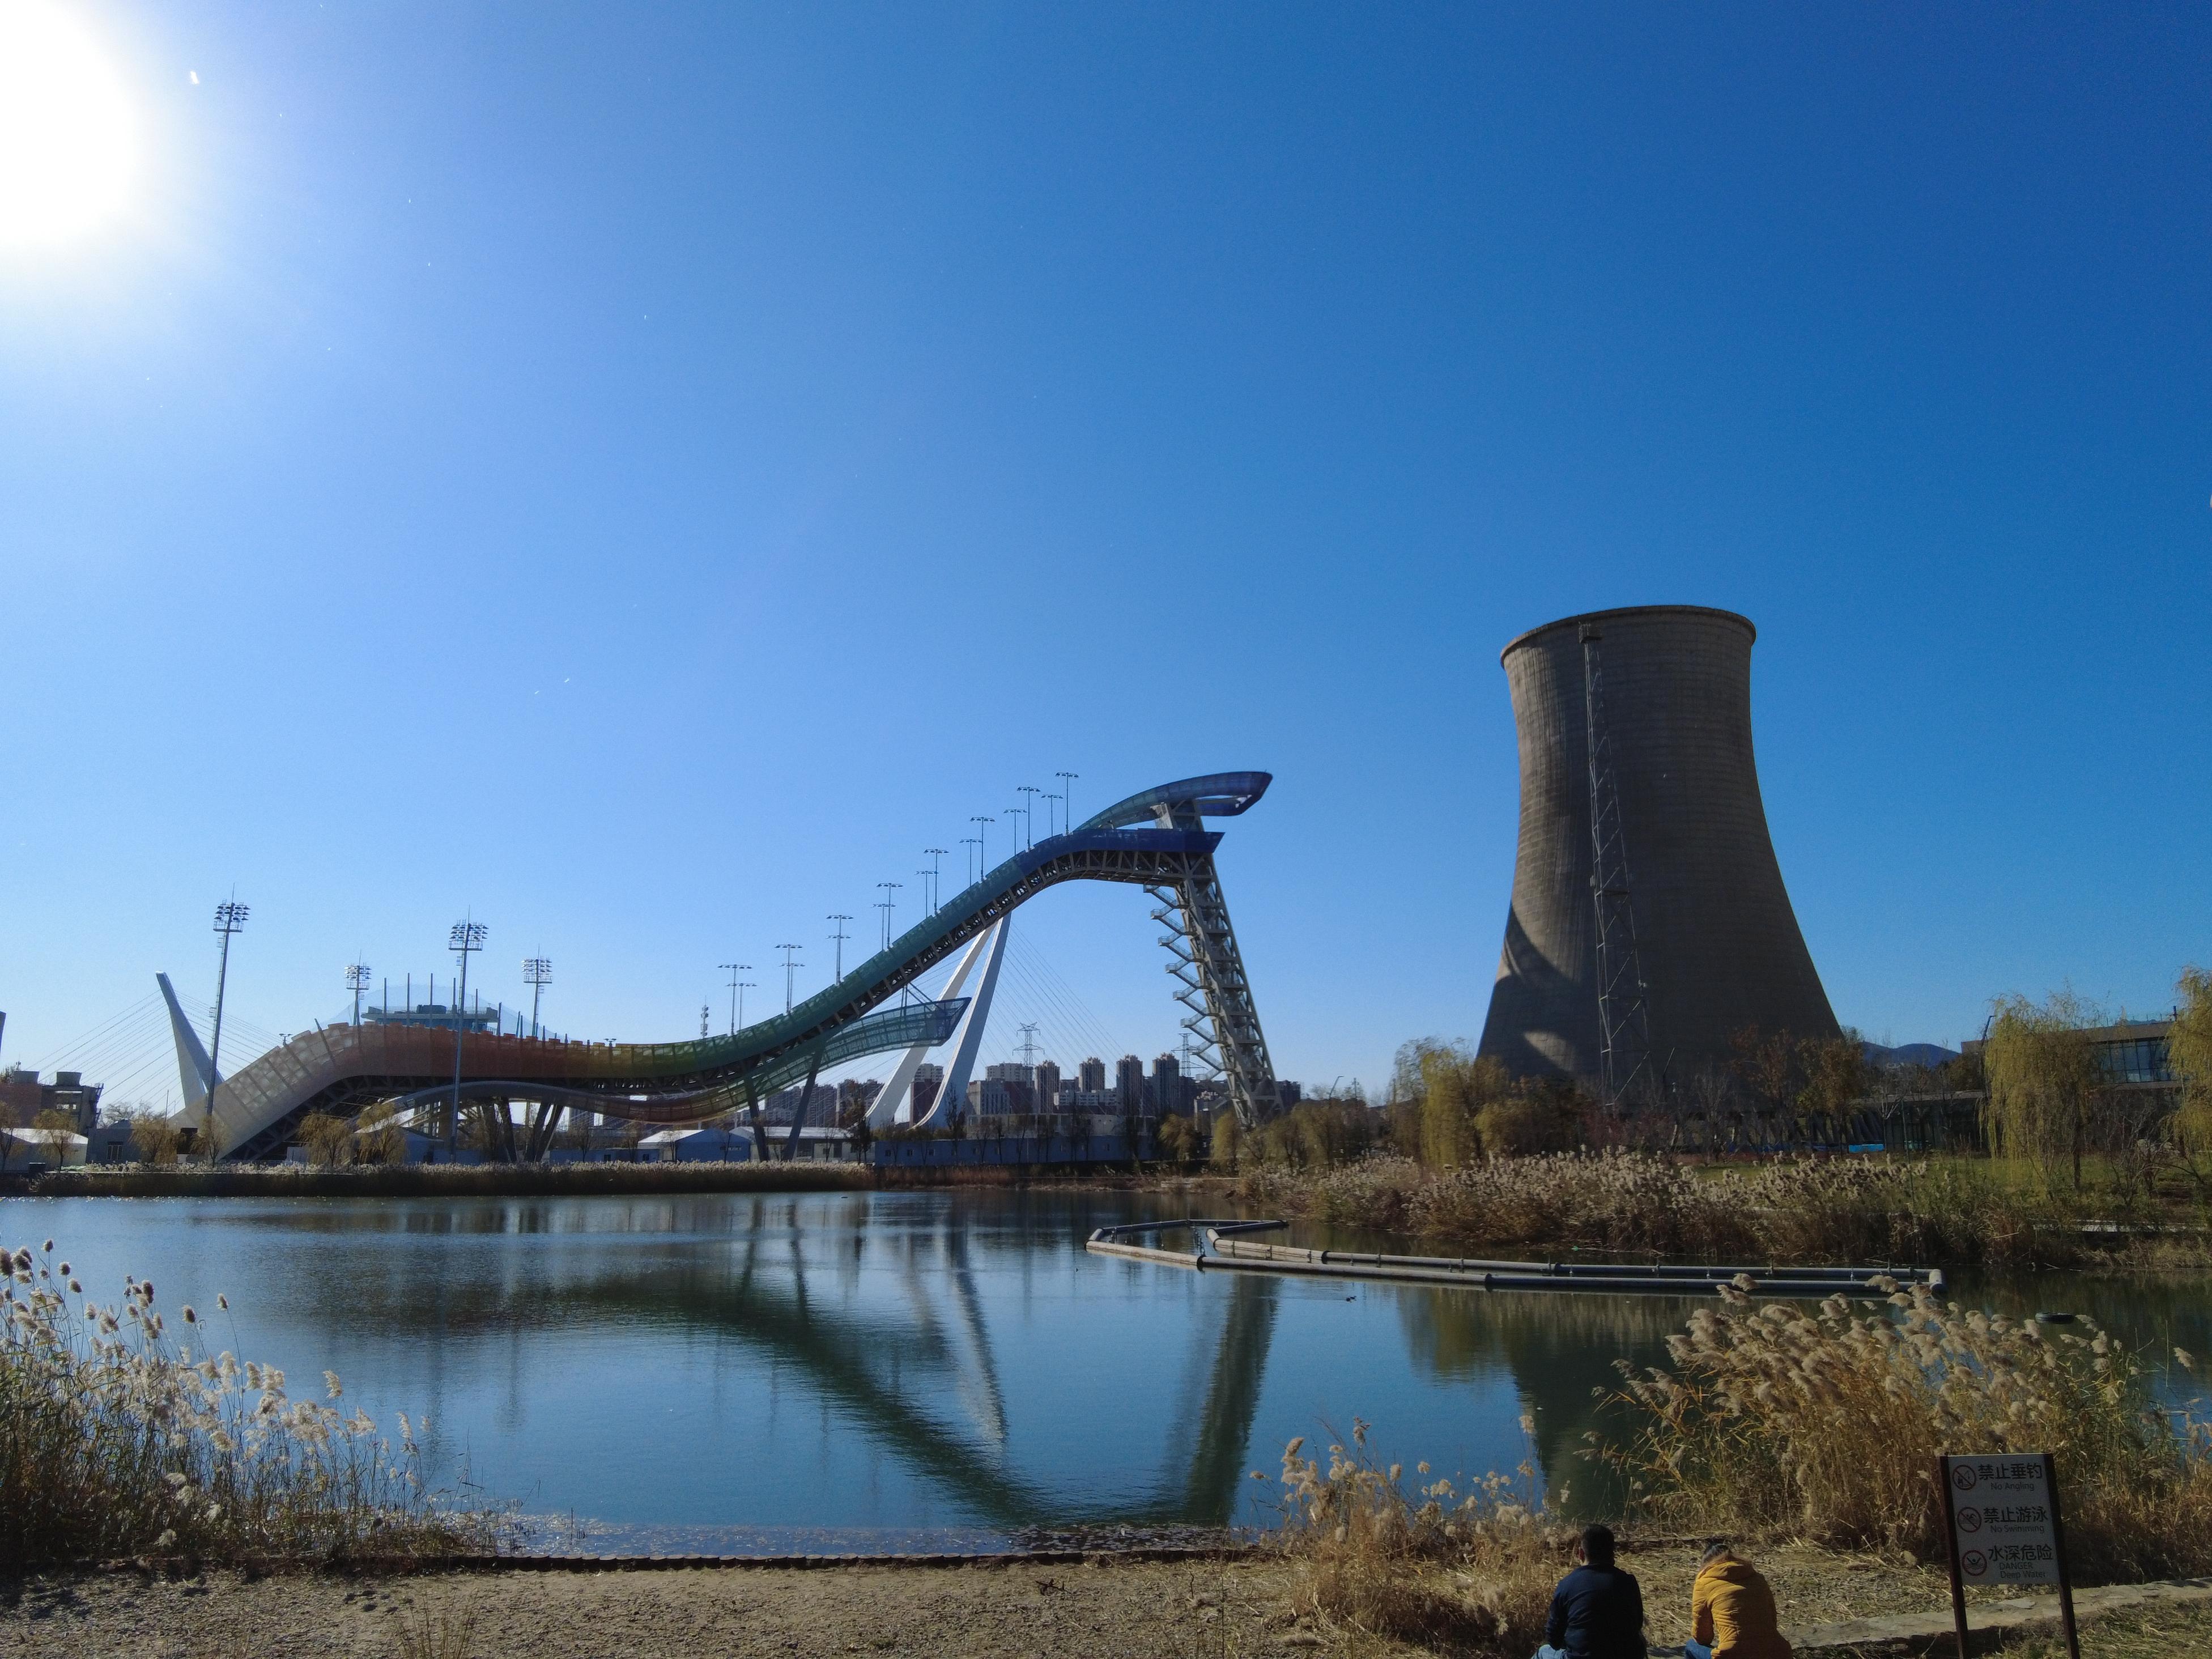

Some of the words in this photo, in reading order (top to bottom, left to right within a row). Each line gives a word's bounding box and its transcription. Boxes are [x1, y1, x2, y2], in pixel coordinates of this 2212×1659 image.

[1978, 1464, 2043, 1480] 禁止垂钓
[2005, 1482, 2034, 1491] Angling
[1983, 1507, 2048, 1524] 禁止游泳
[2004, 1525, 2044, 1534] Swimming
[1989, 1544, 2053, 1561] 水深危险
[2001, 1571, 2021, 1579] Deep
